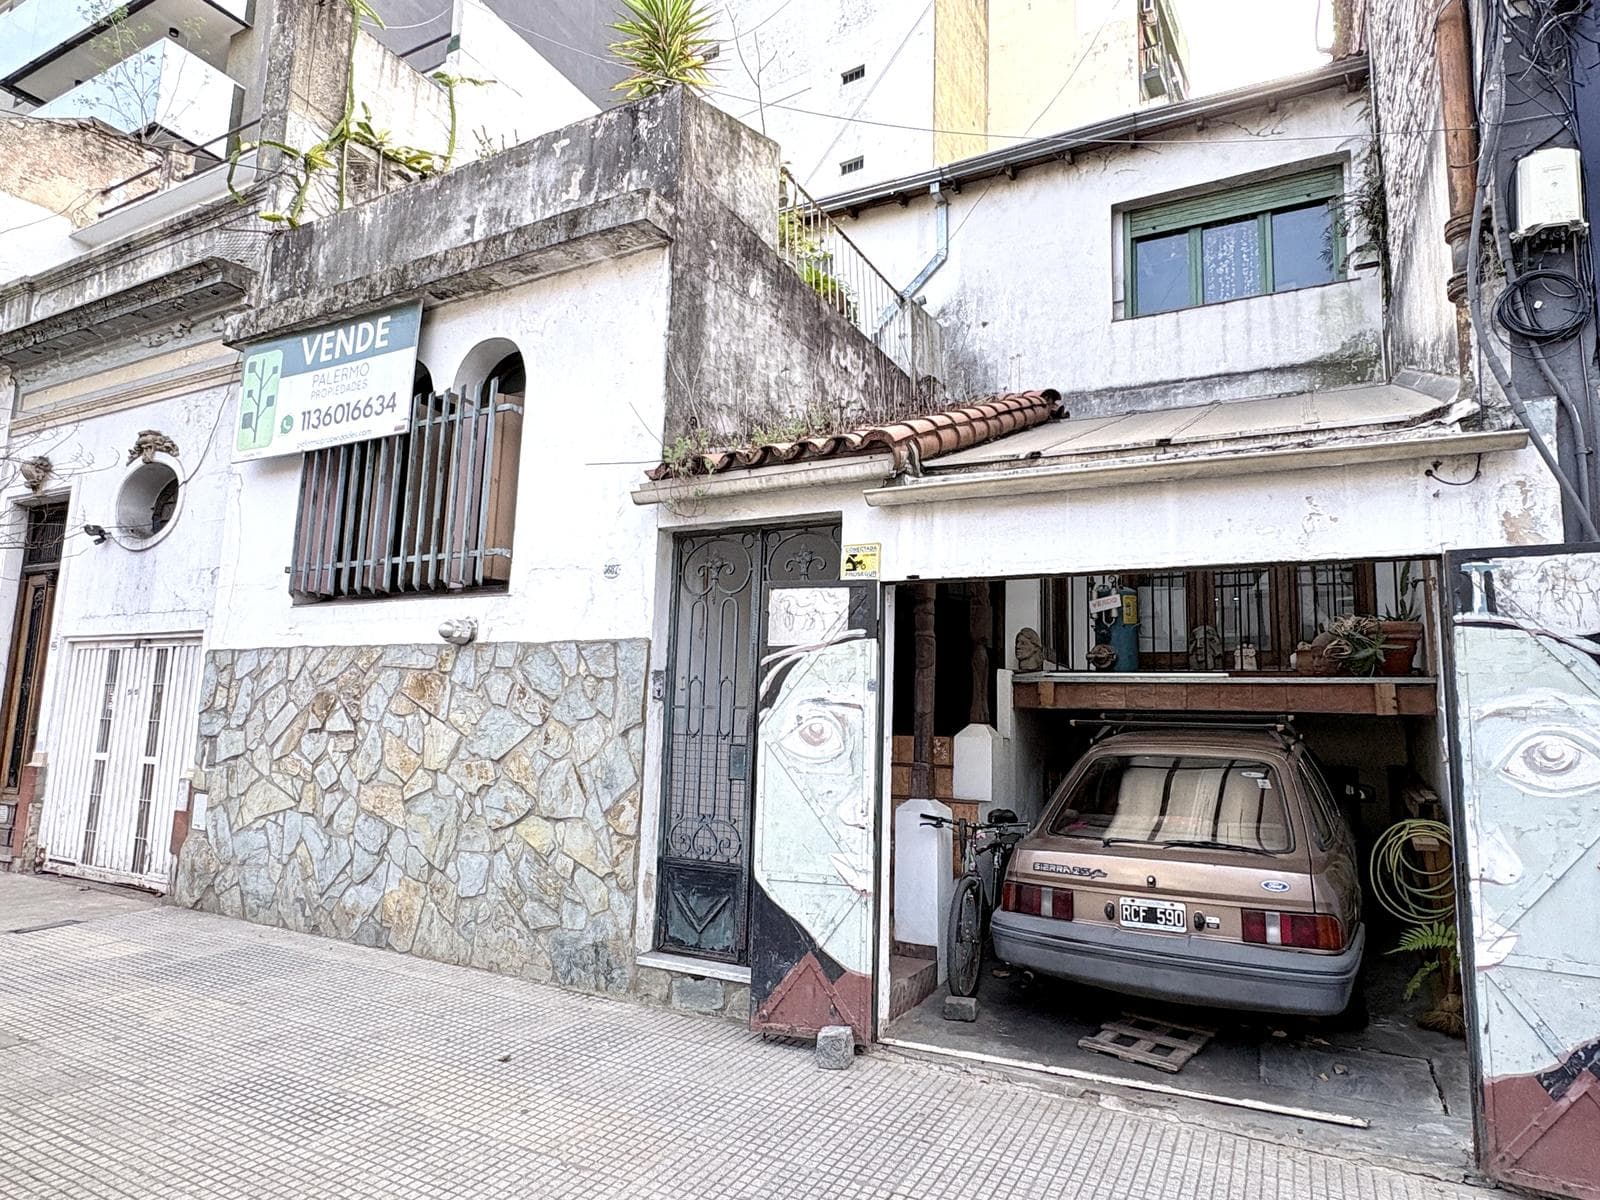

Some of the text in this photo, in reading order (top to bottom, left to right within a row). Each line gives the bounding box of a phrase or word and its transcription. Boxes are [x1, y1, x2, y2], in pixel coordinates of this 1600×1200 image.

[302, 315, 392, 366] VENDE
[312, 362, 370, 388] PALERMO
[310, 378, 368, 400] PROPIEDADES
[301, 392, 397, 431] 1136016634
[1033, 862, 1072, 874] SIERRA
[1122, 905, 1149, 922] RCF
[1156, 907, 1184, 927] 590
